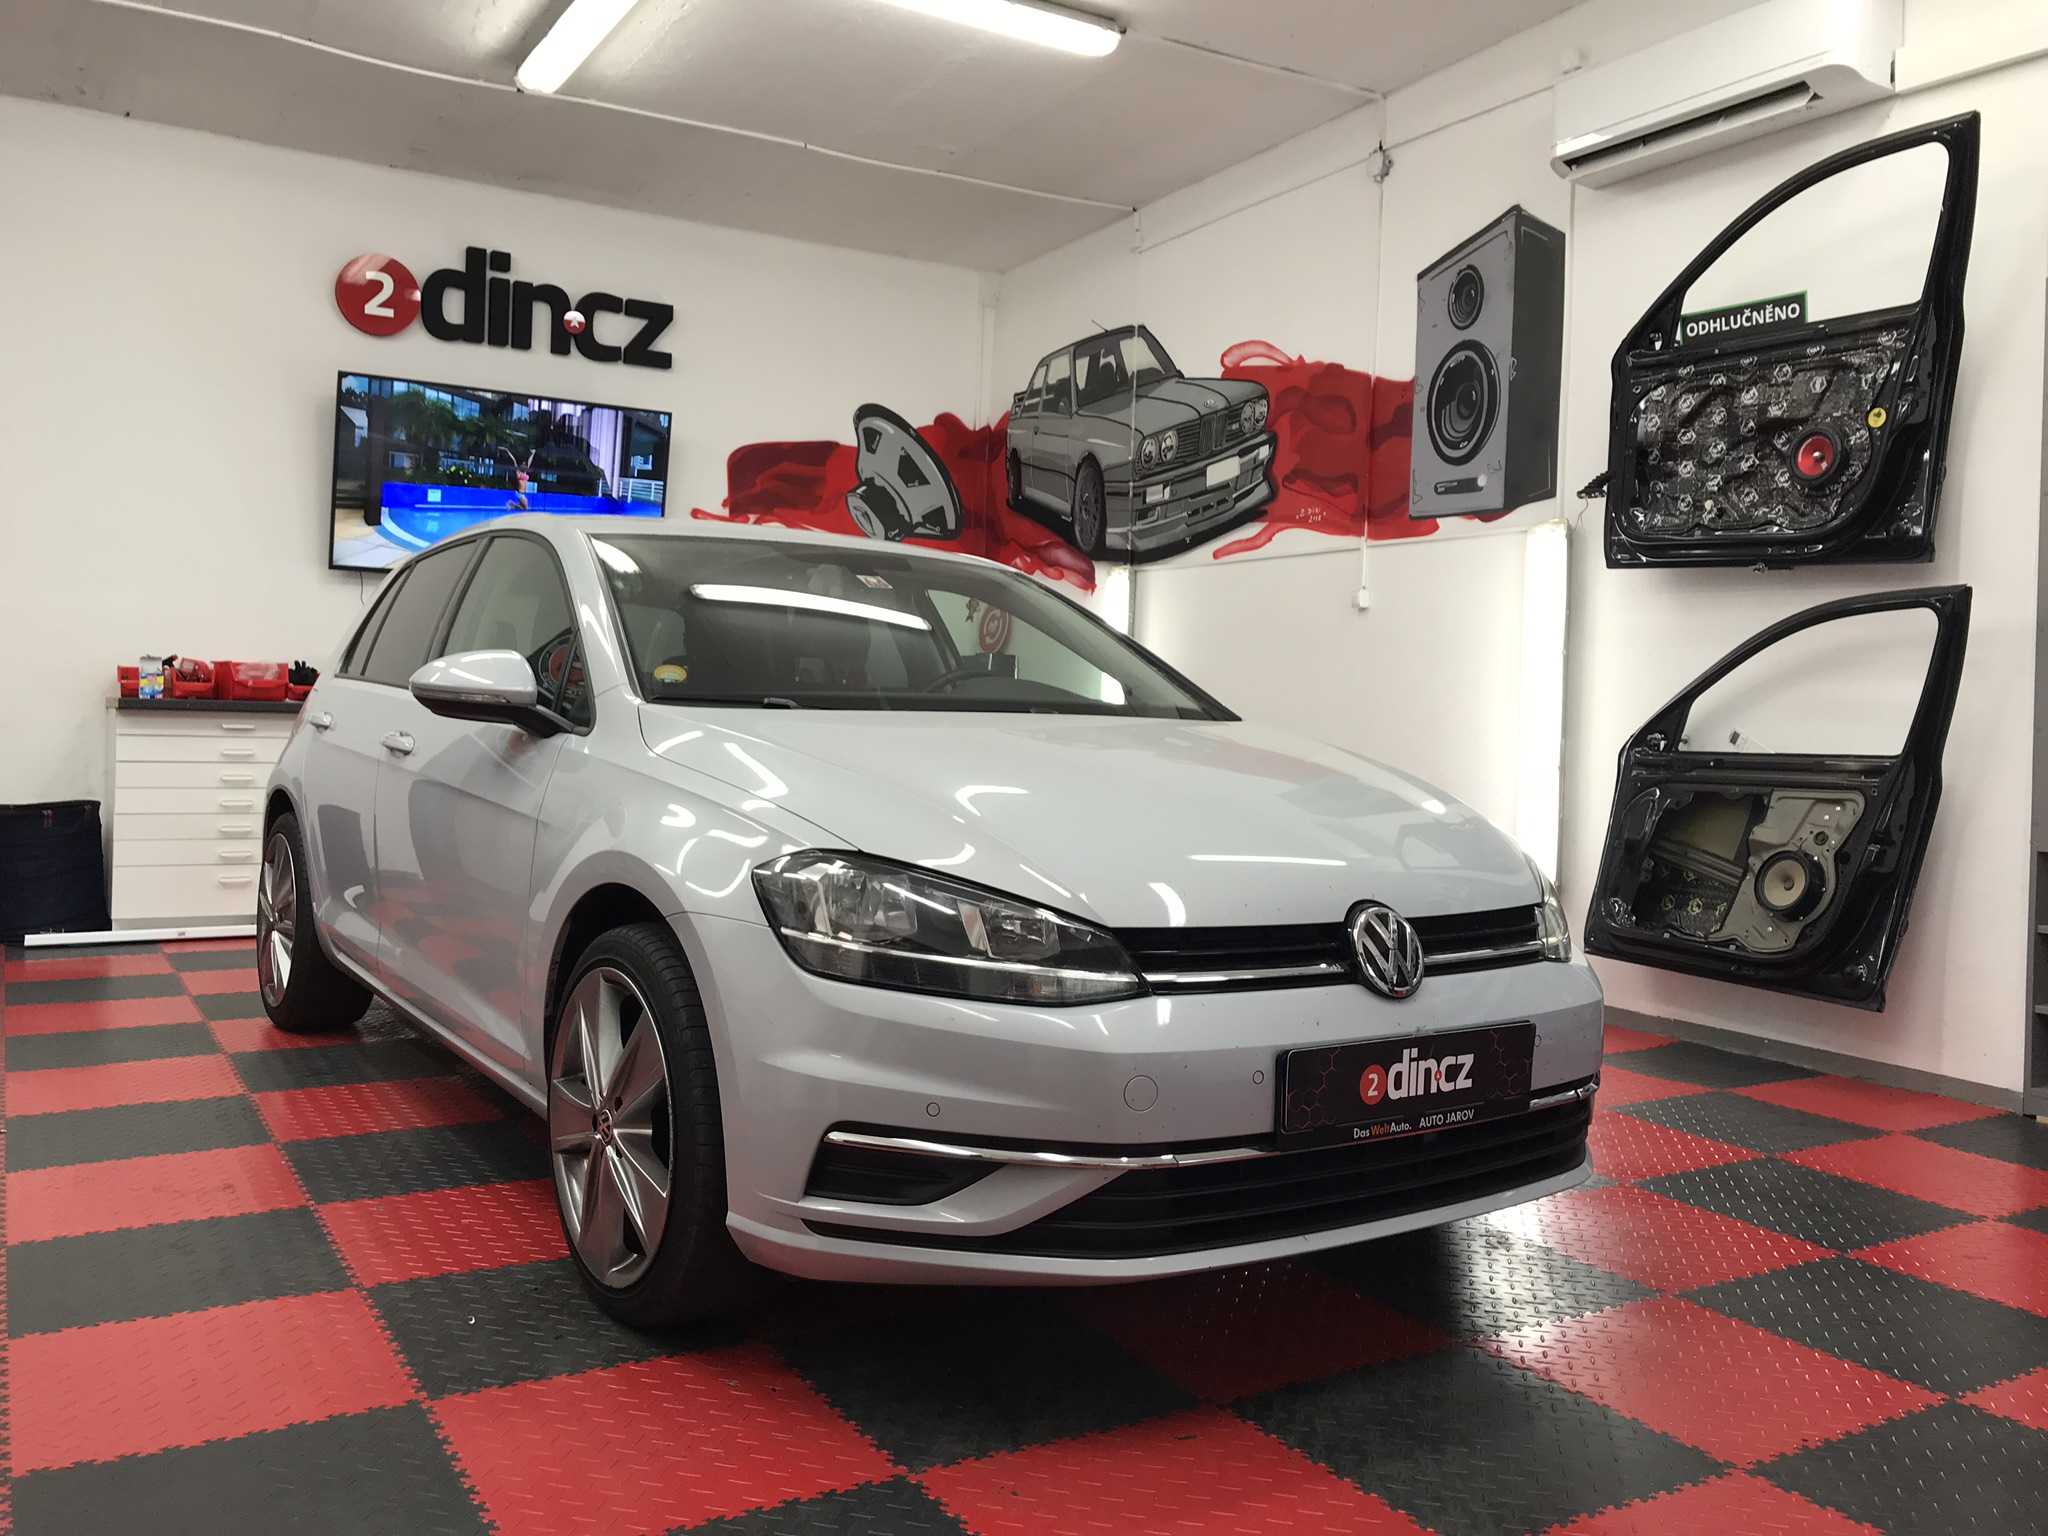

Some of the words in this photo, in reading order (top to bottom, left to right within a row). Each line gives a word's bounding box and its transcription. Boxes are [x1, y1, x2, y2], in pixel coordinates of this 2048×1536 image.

[1686, 303, 1801, 337] ODHLUČNĚNO
[1353, 1127, 1370, 1139] Das
[1419, 1114, 1445, 1129] AUTO
[1445, 1109, 1475, 1124] JAROV
